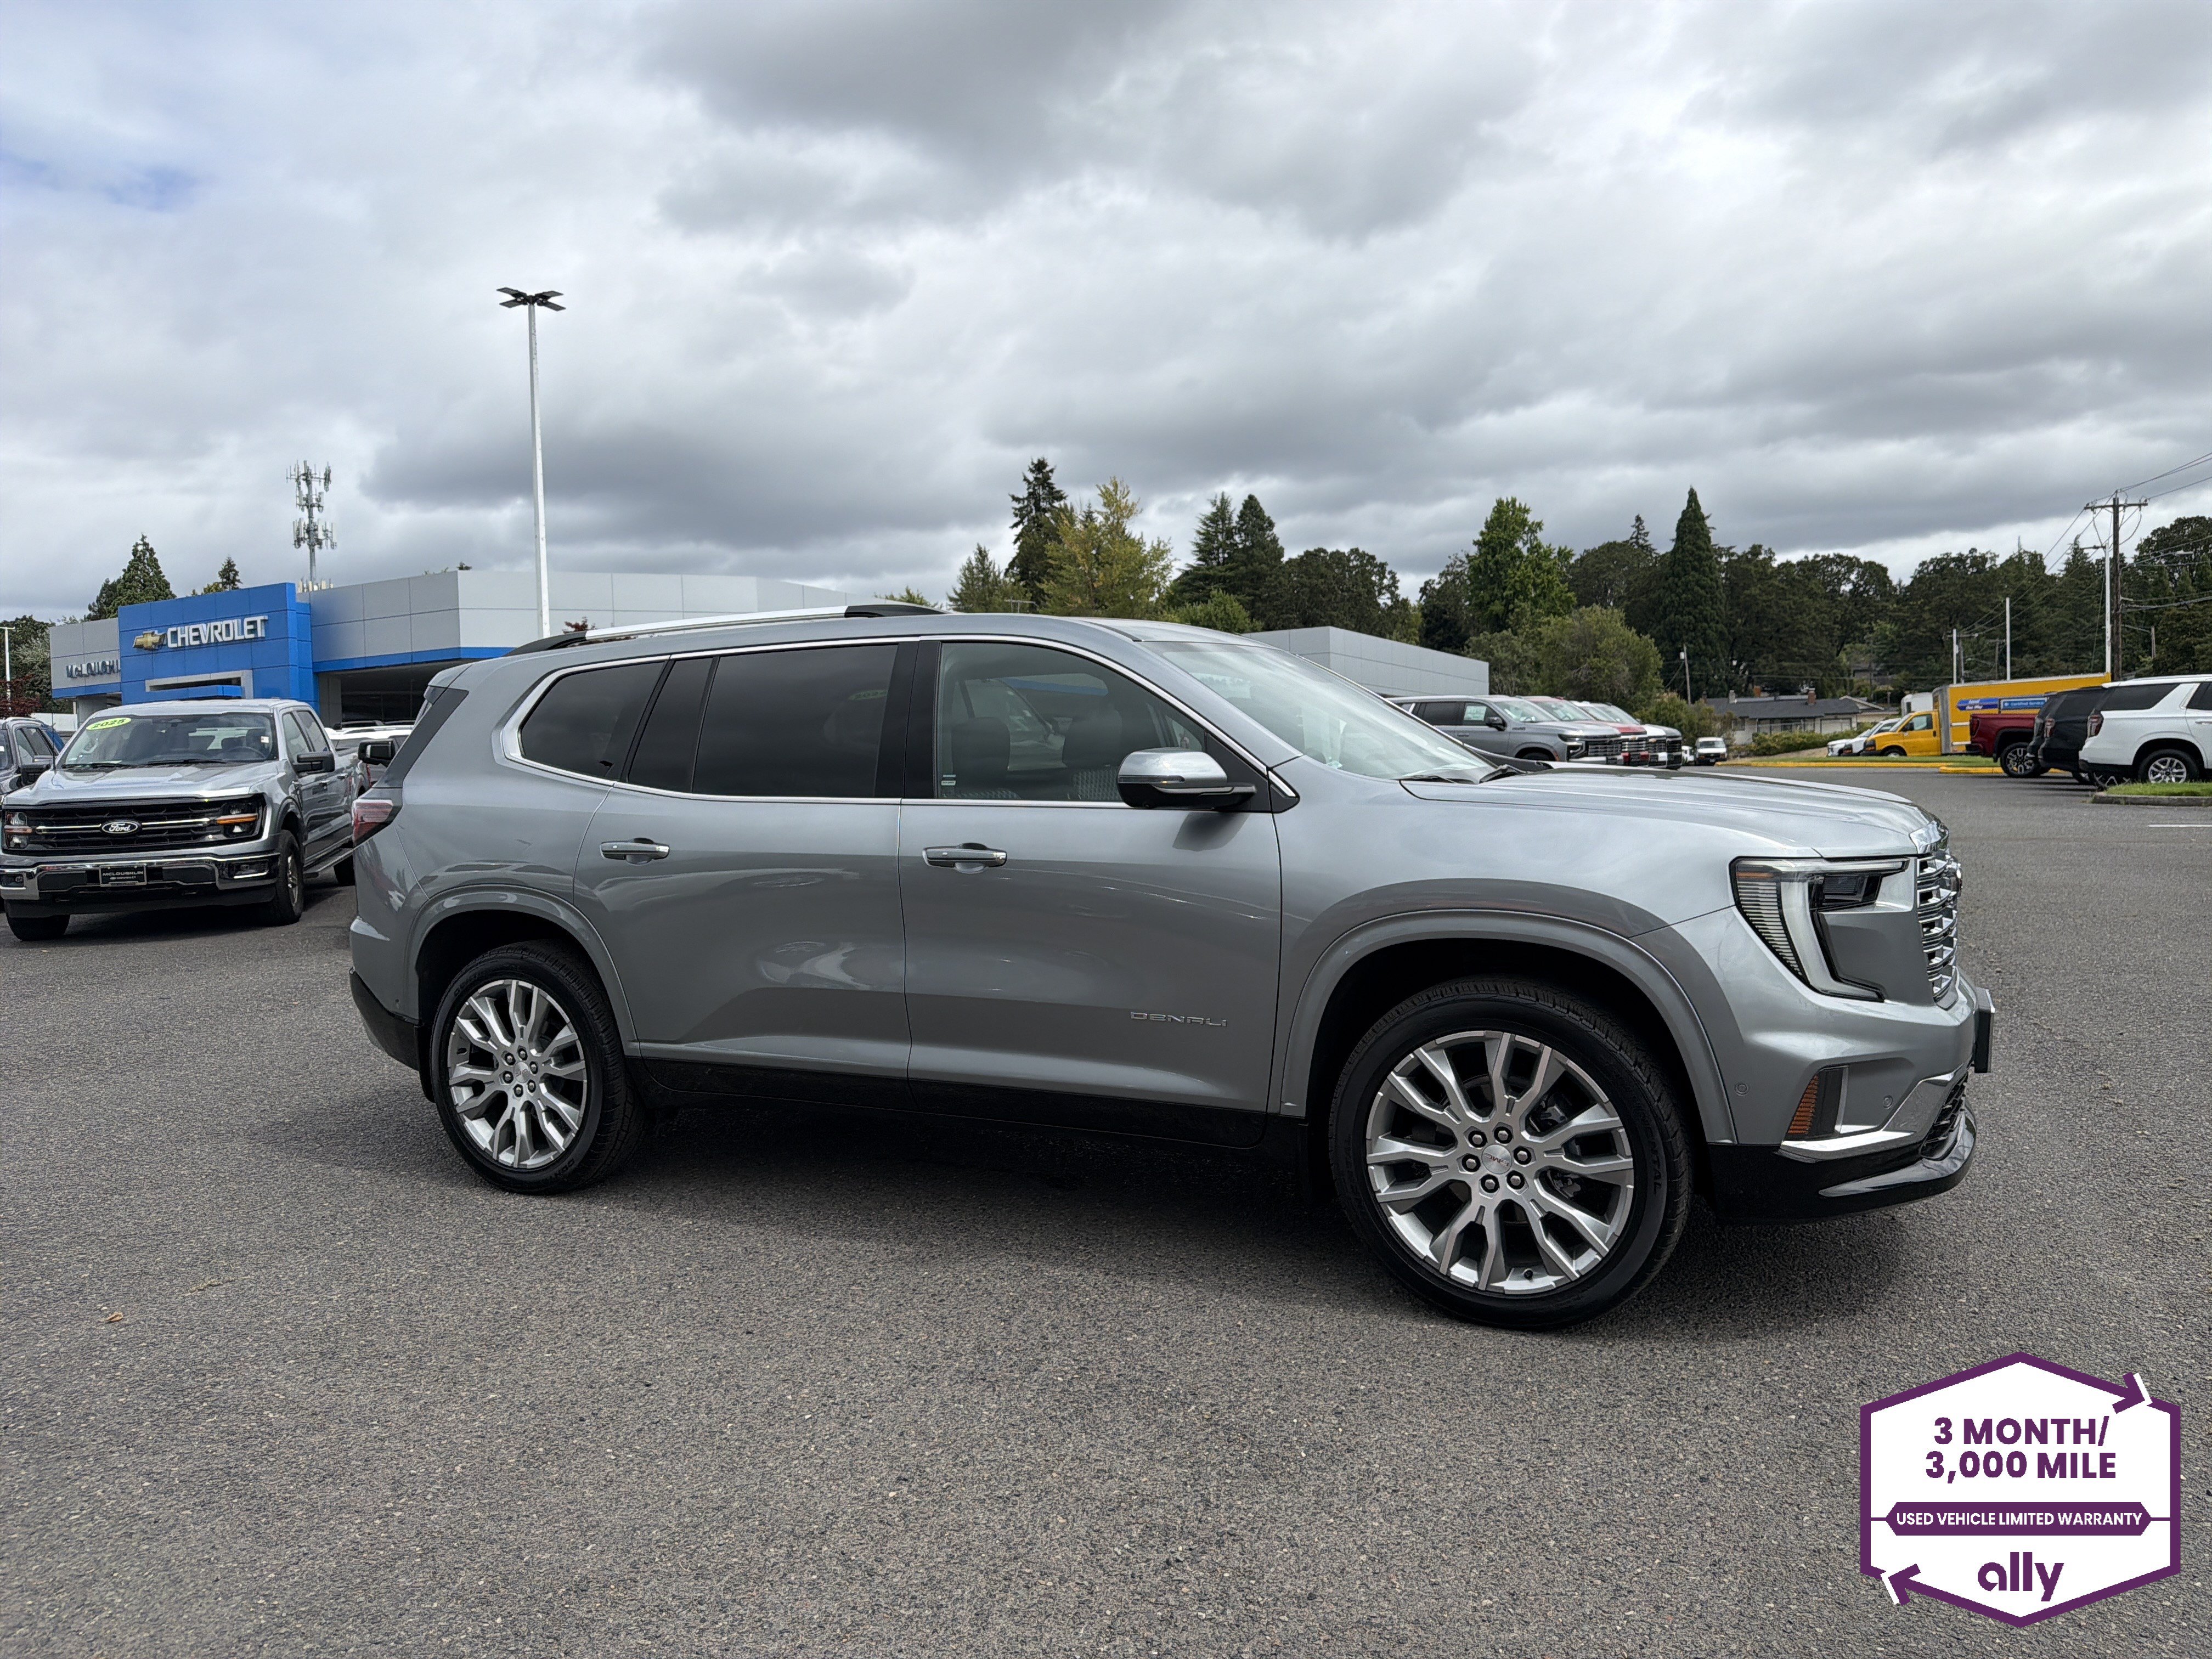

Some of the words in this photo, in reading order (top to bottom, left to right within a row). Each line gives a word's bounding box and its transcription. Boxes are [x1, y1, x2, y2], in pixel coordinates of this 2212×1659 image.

[167, 616, 268, 648] CHEVROLET
[91, 718, 127, 729] 2025
[109, 823, 132, 832] Ford
[1130, 1012, 1228, 1028] DENALI
